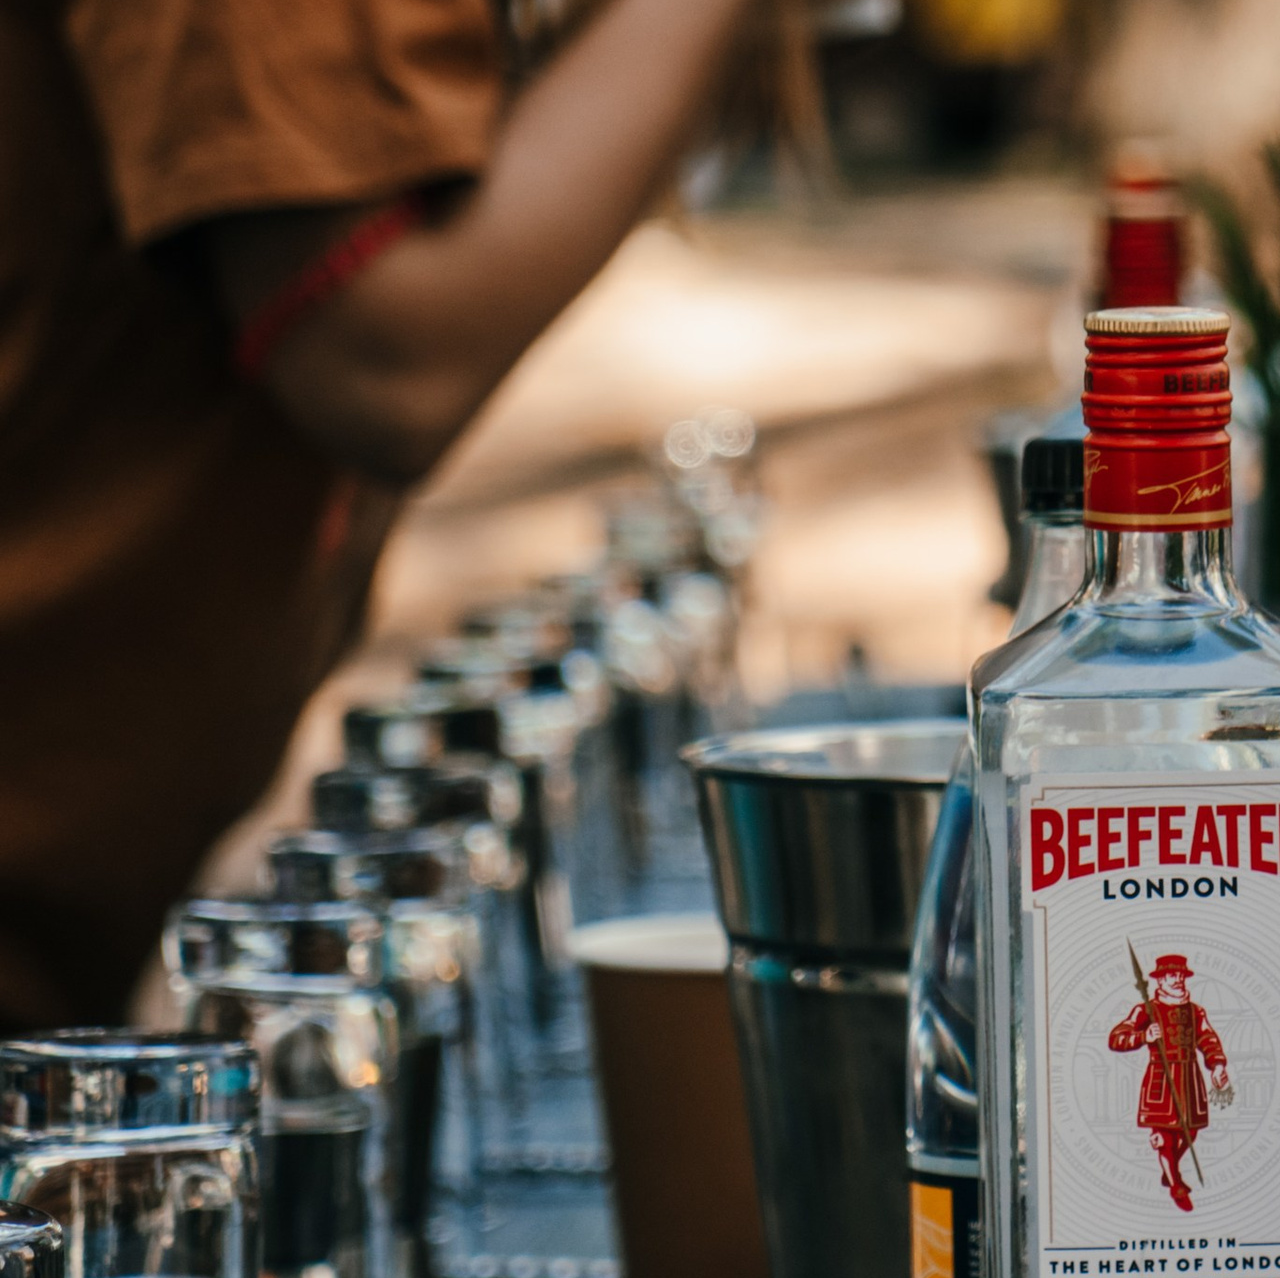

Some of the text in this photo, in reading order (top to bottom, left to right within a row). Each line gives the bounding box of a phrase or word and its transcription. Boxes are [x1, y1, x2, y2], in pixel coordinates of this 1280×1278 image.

[1104, 876, 1239, 900] LONDON
[1193, 951, 1271, 1004] EXHIBITION
[1052, 1004, 1084, 1058] ANNUAL
[1073, 1135, 1153, 1192] INVENTIONS
[1119, 1238, 1237, 1251] DISTILLED IN
[1050, 1260, 1090, 1274] THE
[1099, 1259, 1168, 1273] HEART
[1177, 1258, 1204, 1271] OF
